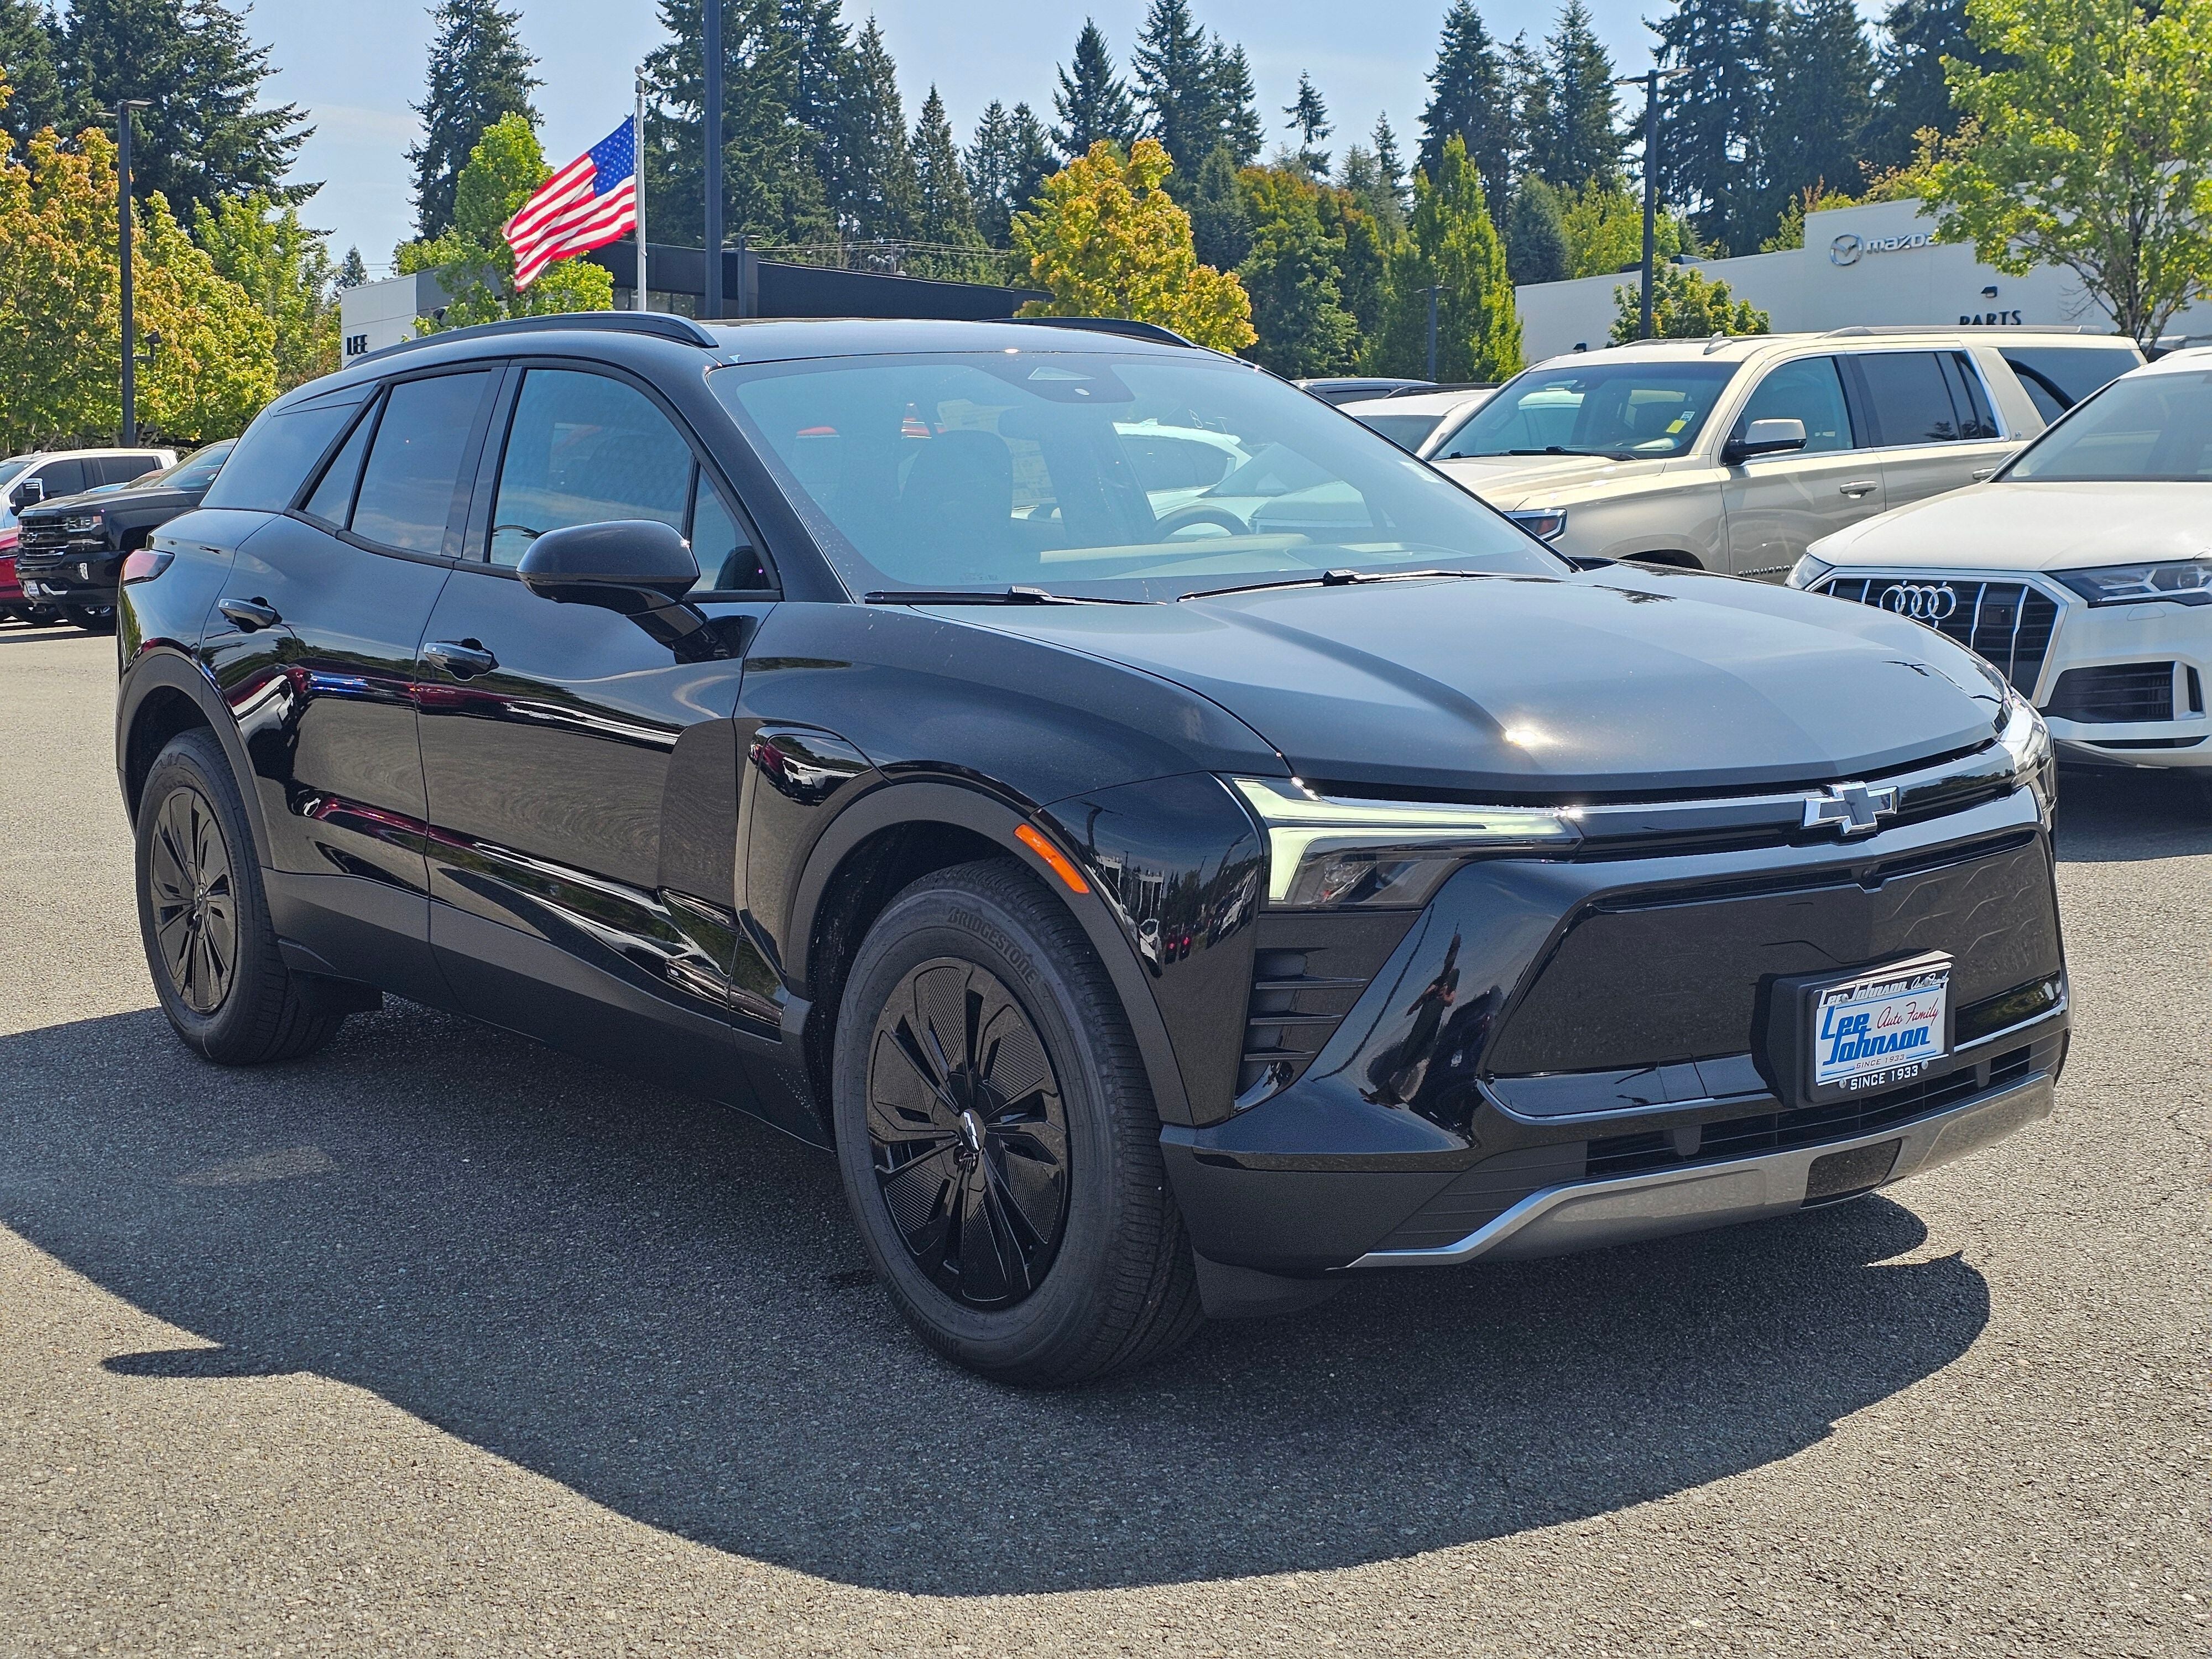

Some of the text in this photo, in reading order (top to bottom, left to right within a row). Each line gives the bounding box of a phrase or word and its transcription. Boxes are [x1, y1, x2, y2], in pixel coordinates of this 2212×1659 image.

[1959, 310, 2022, 325] PARTS
[346, 334, 368, 356] LEE
[946, 906, 1039, 984] BRIDGESTONE
[1848, 982, 1908, 1002] Johnson
[1820, 997, 1939, 1040] Lee Auto Family
[1823, 1026, 1931, 1066] Johnson
[1855, 1054, 1905, 1069] SINCE 1933
[1850, 1065, 1918, 1091] SINCE 1933
